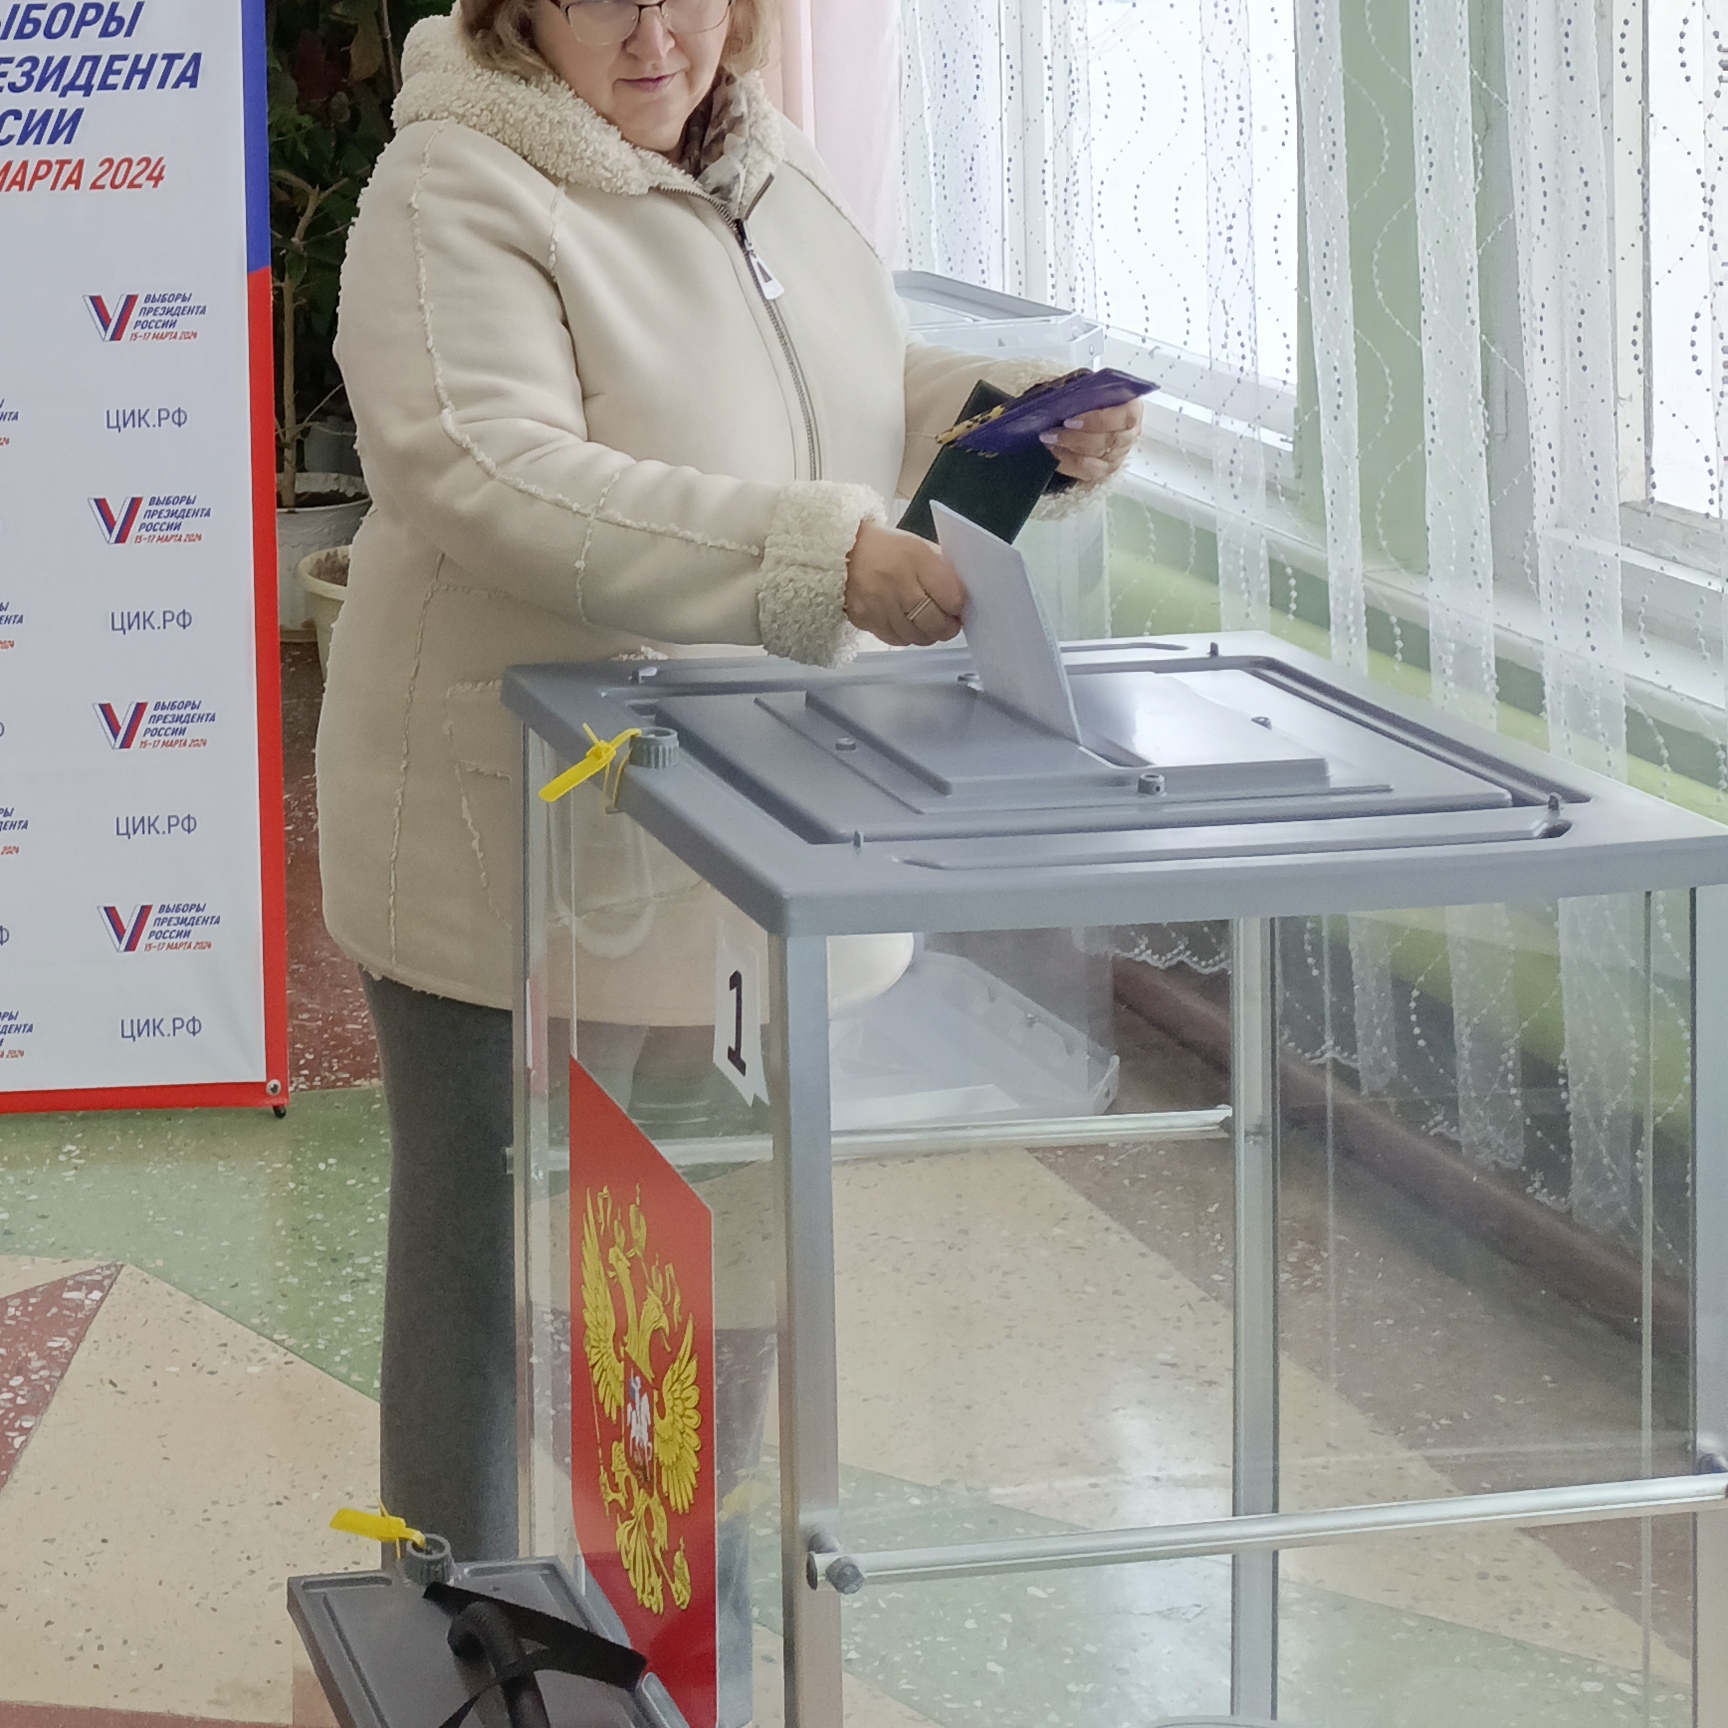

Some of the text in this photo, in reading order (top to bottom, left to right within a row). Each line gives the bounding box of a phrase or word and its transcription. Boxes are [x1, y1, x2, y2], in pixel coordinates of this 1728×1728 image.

[89, 156, 166, 191] 2024
[143, 292, 193, 303] ВЫБОРЫ
[138, 305, 207, 318] ПРЕЗИДЕНТА
[132, 318, 178, 330] РОССИИ
[152, 331, 177, 341] МАРТА
[179, 331, 198, 340] 2024
[106, 407, 187, 432] ЦИК.РФ
[147, 495, 197, 506] ВЫБОРЫ
[142, 507, 212, 520] ПРЕЗИДЕНТА
[137, 521, 183, 533] РОССИИ
[156, 533, 182, 544] МАРТА
[184, 533, 203, 543] 2024
[111, 609, 192, 635] ЦИК.РФ
[153, 700, 202, 711] ВЫБОРЫ
[147, 712, 216, 725] ПРЕЗИДЕНТА
[142, 726, 188, 738] РОССИИ
[161, 738, 189, 748] МАРТА
[188, 738, 208, 748] 2024
[116, 814, 197, 839] ЦИК.РФ
[1, 845, 20, 856] 2024
[157, 903, 207, 914] ВЫБОРЫ
[152, 915, 221, 928] ПРЕЗИДЕНТА
[147, 929, 192, 941] РОССИИ
[166, 941, 192, 951] МАРТА
[194, 941, 212, 950] 2024
[121, 1016, 201, 1042] ЦИК.РФ
[728, 970, 747, 1077] 1
[6, 1049, 25, 1059] 2024
